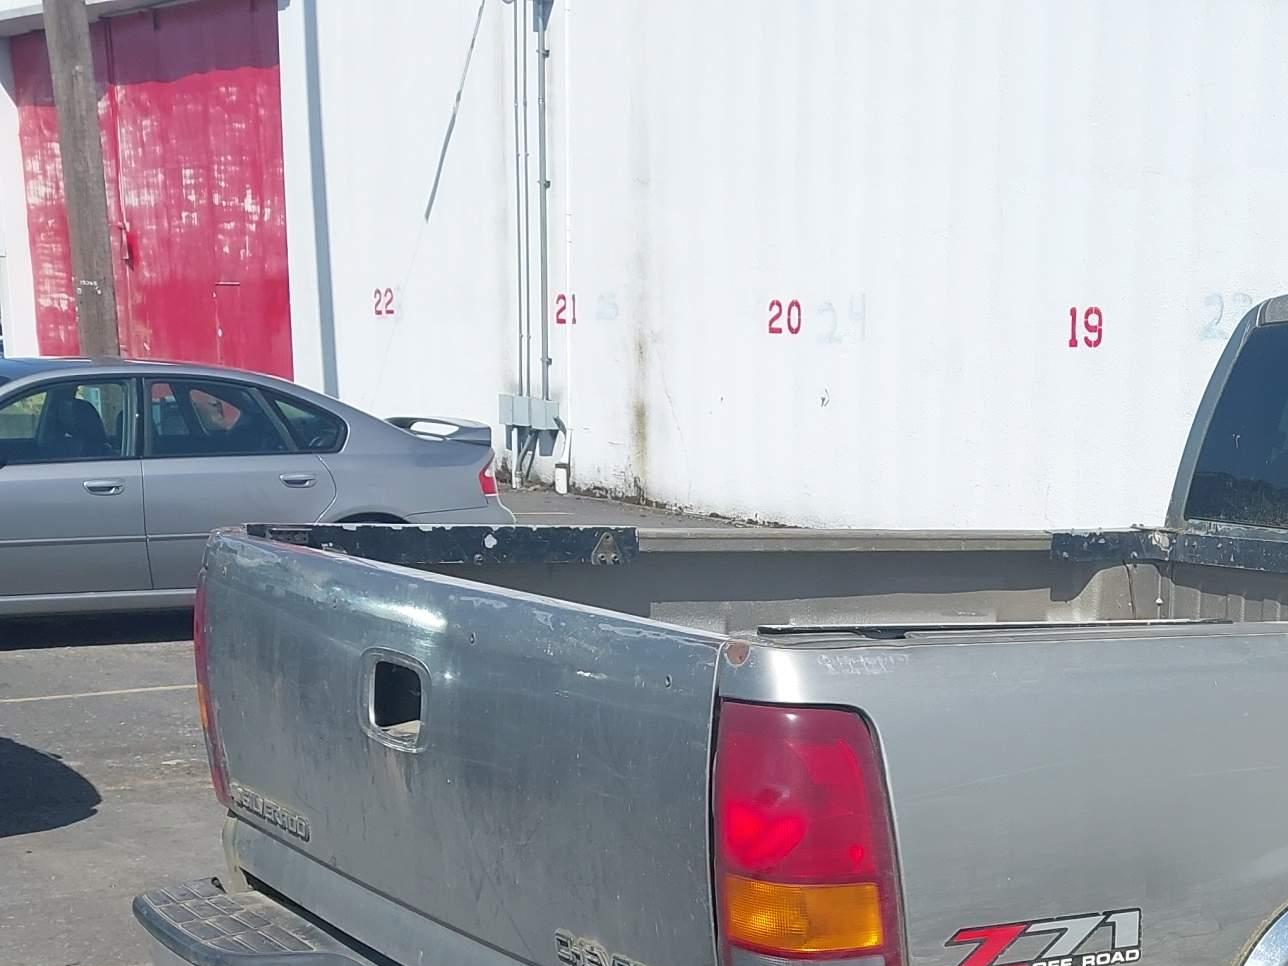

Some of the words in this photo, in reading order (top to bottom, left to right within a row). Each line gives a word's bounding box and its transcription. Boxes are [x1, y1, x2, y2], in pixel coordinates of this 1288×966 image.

[373, 288, 395, 315] 22
[555, 294, 577, 324] 21
[768, 299, 802, 334] 20
[1068, 306, 1103, 348] 19
